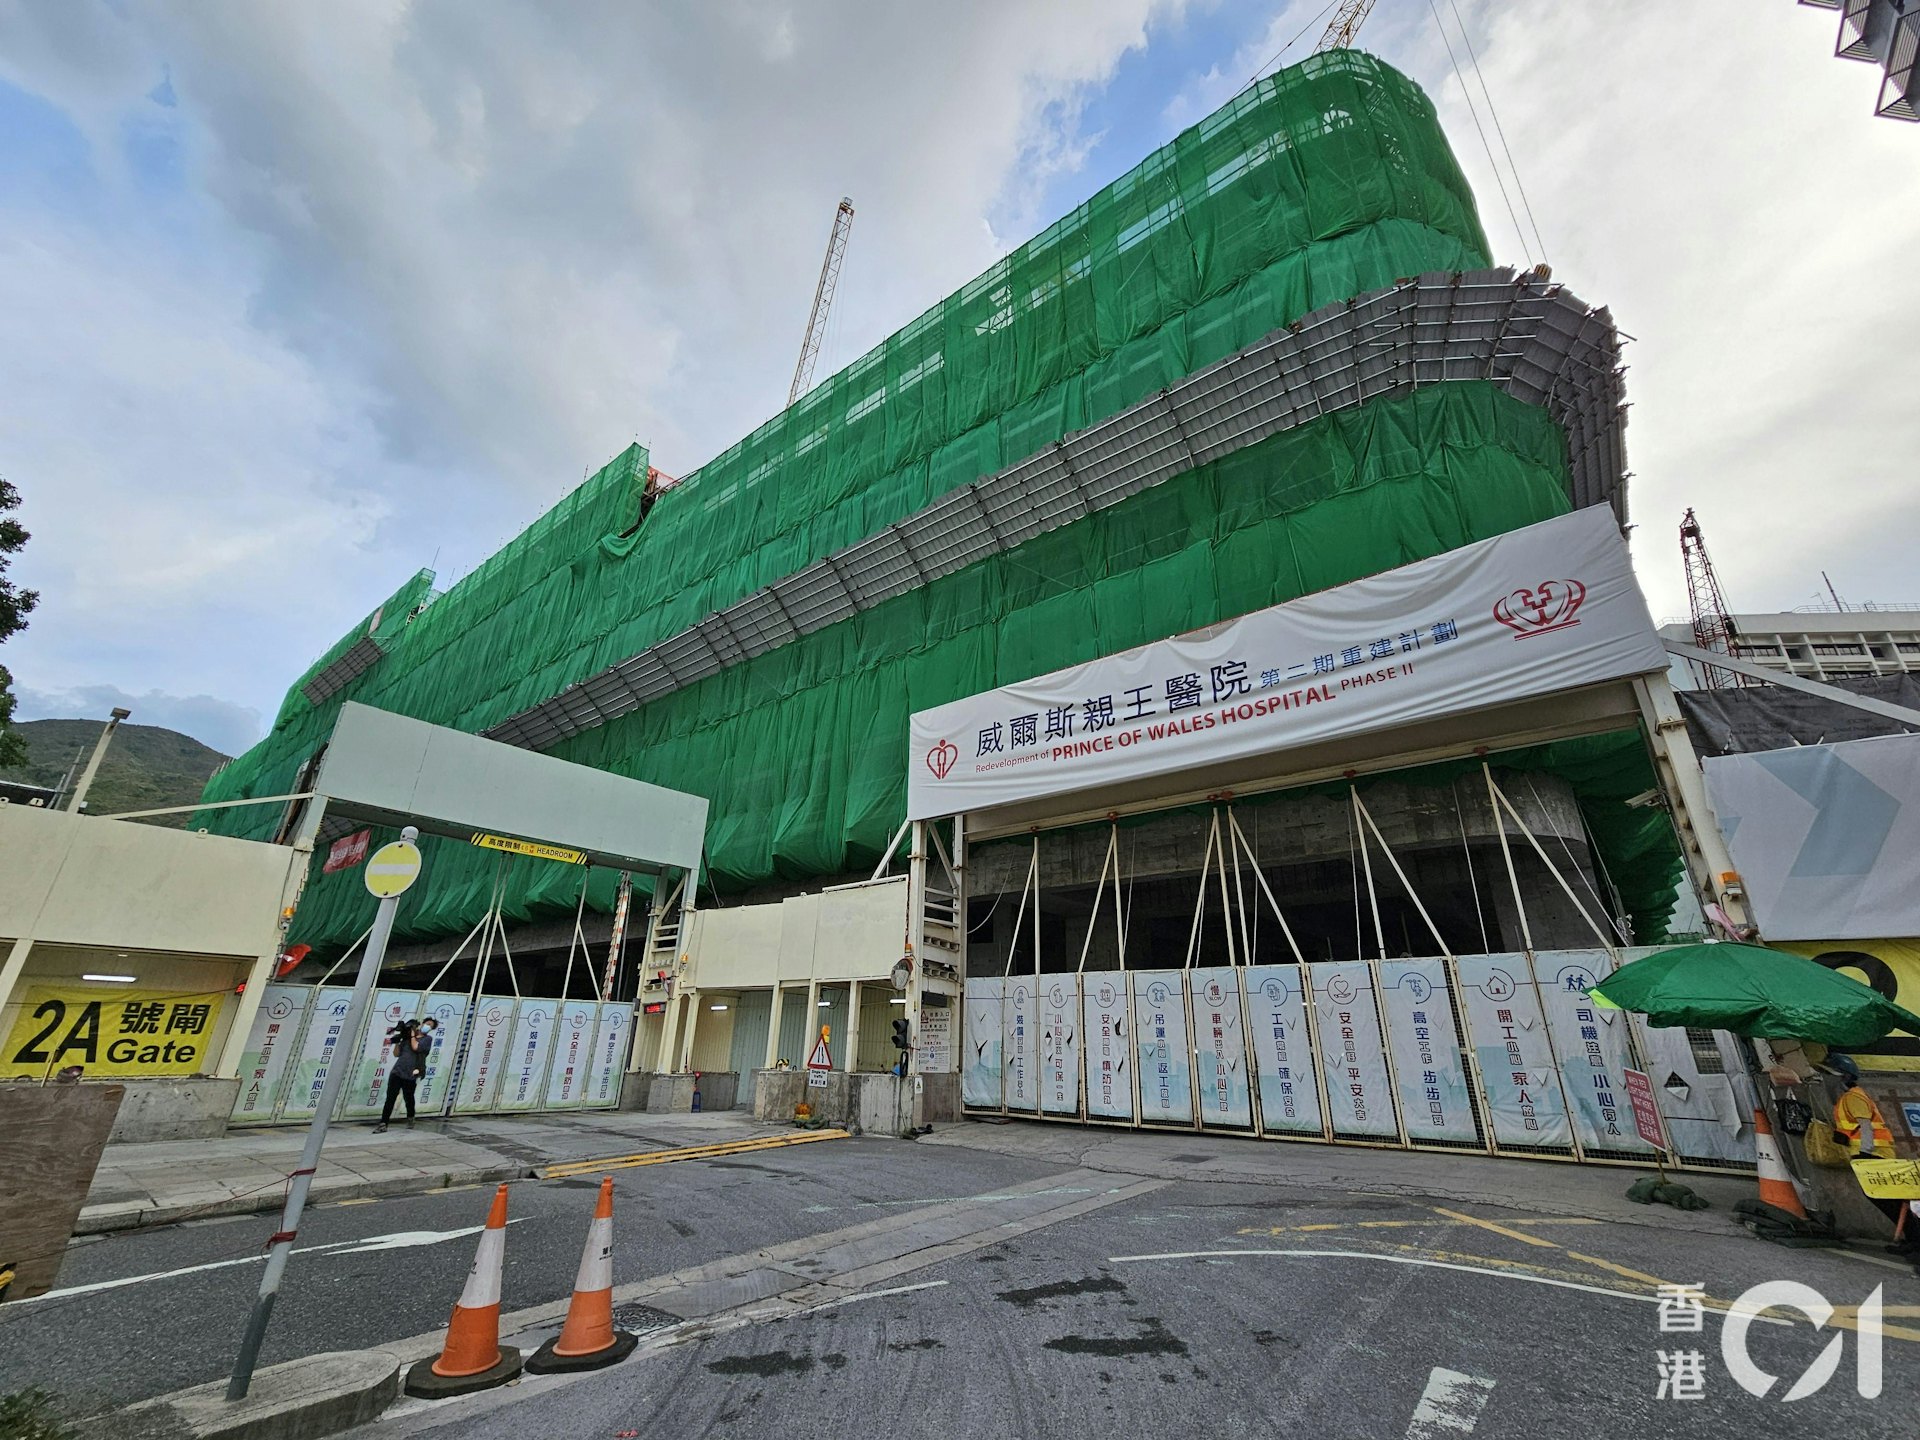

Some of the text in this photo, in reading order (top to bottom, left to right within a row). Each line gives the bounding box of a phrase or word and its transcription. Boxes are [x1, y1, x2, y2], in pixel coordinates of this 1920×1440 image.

[976, 619, 1459, 758] 威爾斯親王醫院 第二期重建計劃
[975, 662, 1414, 773] Redevelopment of PRINCE OF WALES HOSPITAL PHASE II
[488, 838, 521, 851] 高度限制
[536, 847, 574, 860] HEADROOM
[12, 1000, 211, 1063] 2A 號閘
[106, 1038, 196, 1064] Gate
